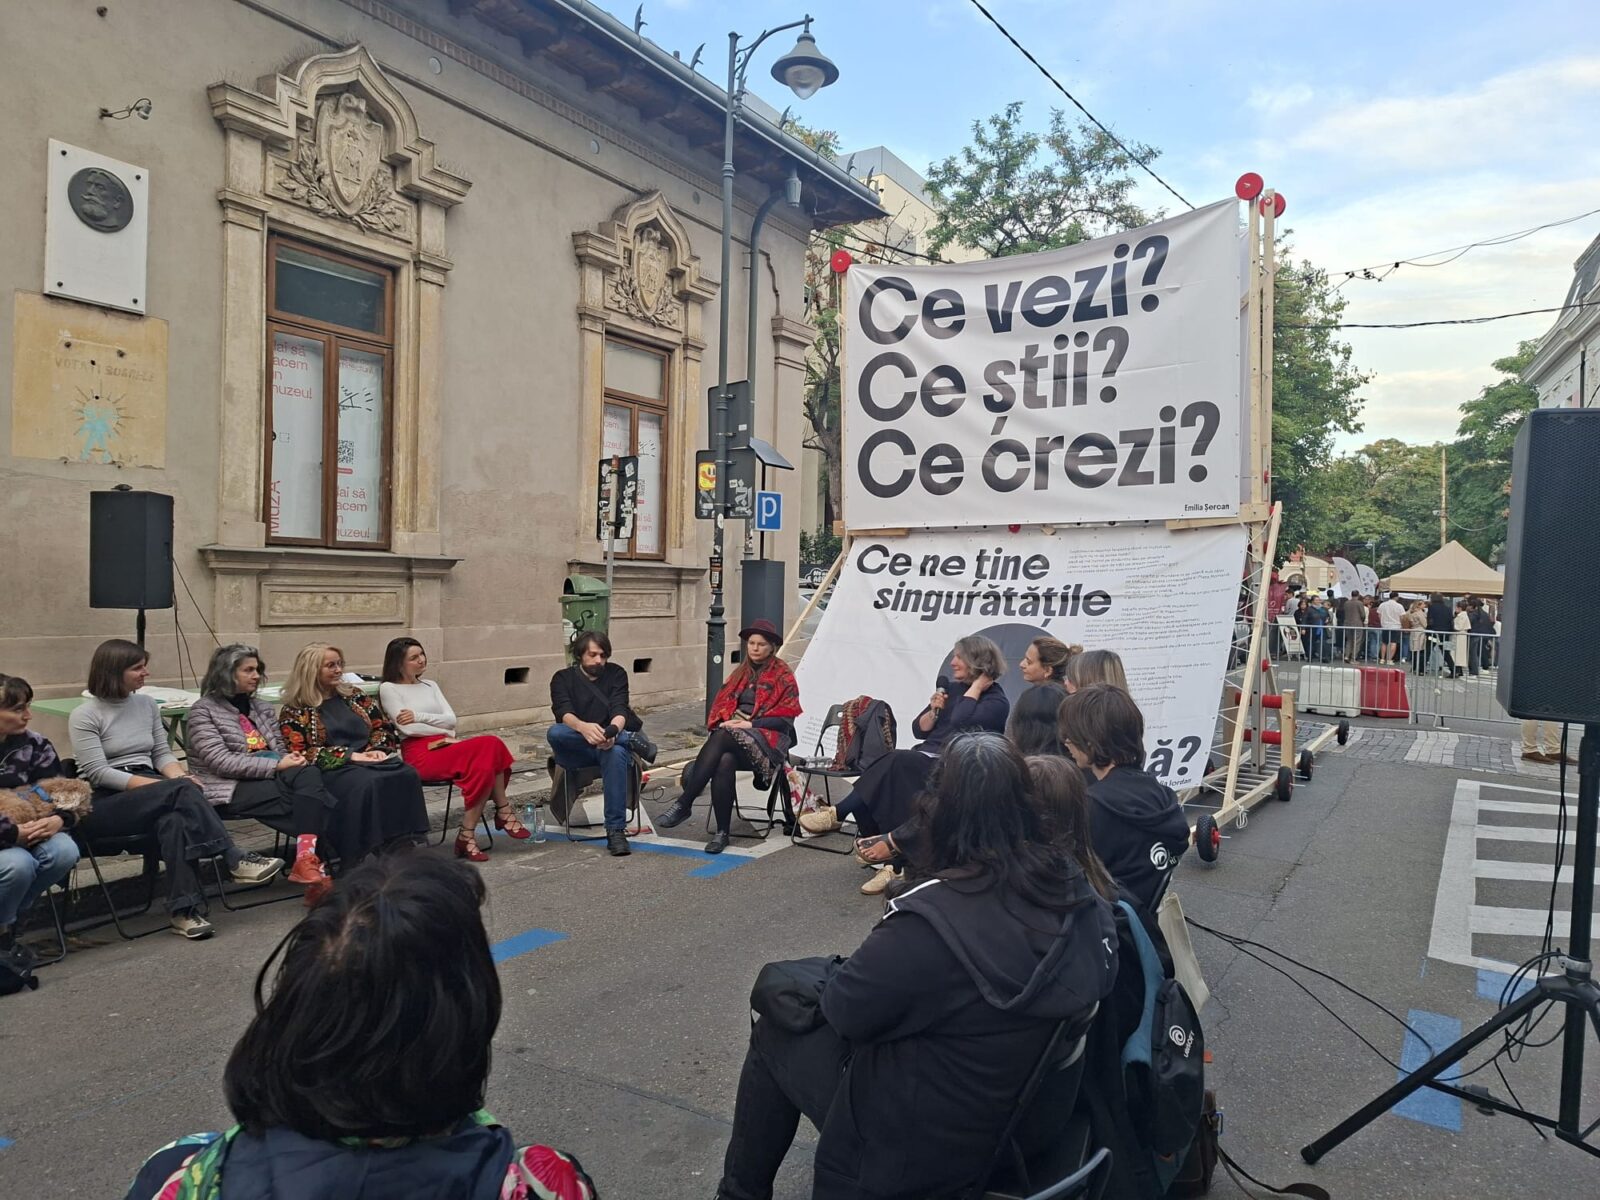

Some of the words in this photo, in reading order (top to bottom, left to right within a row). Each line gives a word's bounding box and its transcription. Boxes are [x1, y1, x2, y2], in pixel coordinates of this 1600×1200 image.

[859, 276, 965, 345] Ce
[984, 234, 1170, 334] vezi?
[272, 356, 308, 371] acem
[858, 352, 966, 422] Ce
[982, 326, 1130, 436] știi?
[857, 429, 965, 499] Ce
[982, 401, 1221, 494] crezi?
[336, 486, 349, 498] ai
[352, 487, 366, 499] să
[336, 500, 368, 512] acem
[761, 496, 777, 526] P
[1184, 503, 1203, 512] Emilia
[856, 543, 912, 577] Ce
[919, 553, 967, 577] ne
[974, 547, 1051, 588] ține
[873, 581, 1112, 628] singurătățile
[1147, 737, 1201, 777] ă?
